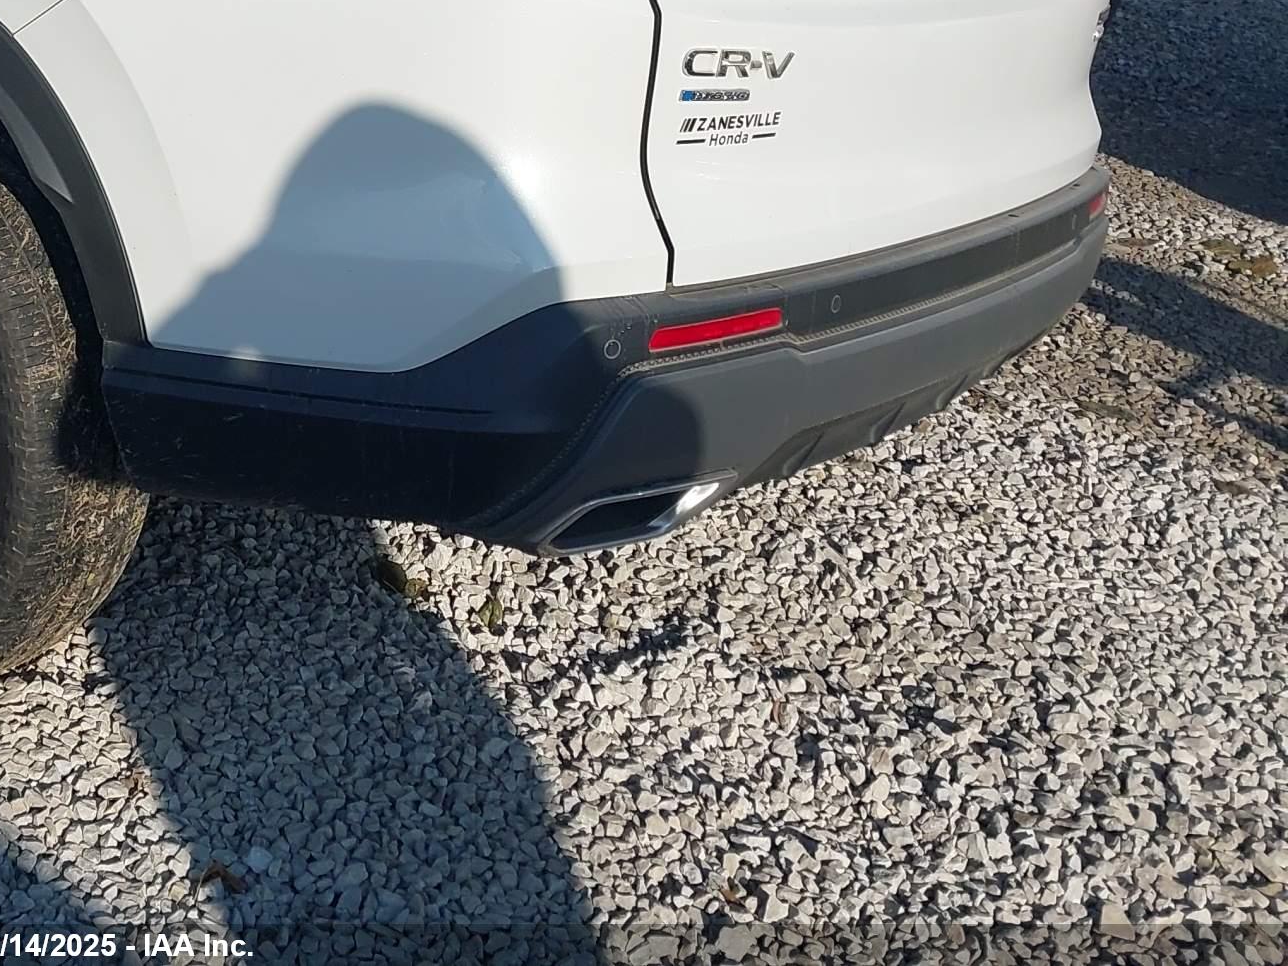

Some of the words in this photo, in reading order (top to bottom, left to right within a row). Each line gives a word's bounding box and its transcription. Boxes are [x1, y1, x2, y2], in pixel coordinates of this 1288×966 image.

[682, 49, 795, 79] CR-V
[697, 112, 781, 132] ZANESVILLE
[709, 132, 749, 146] Honda
